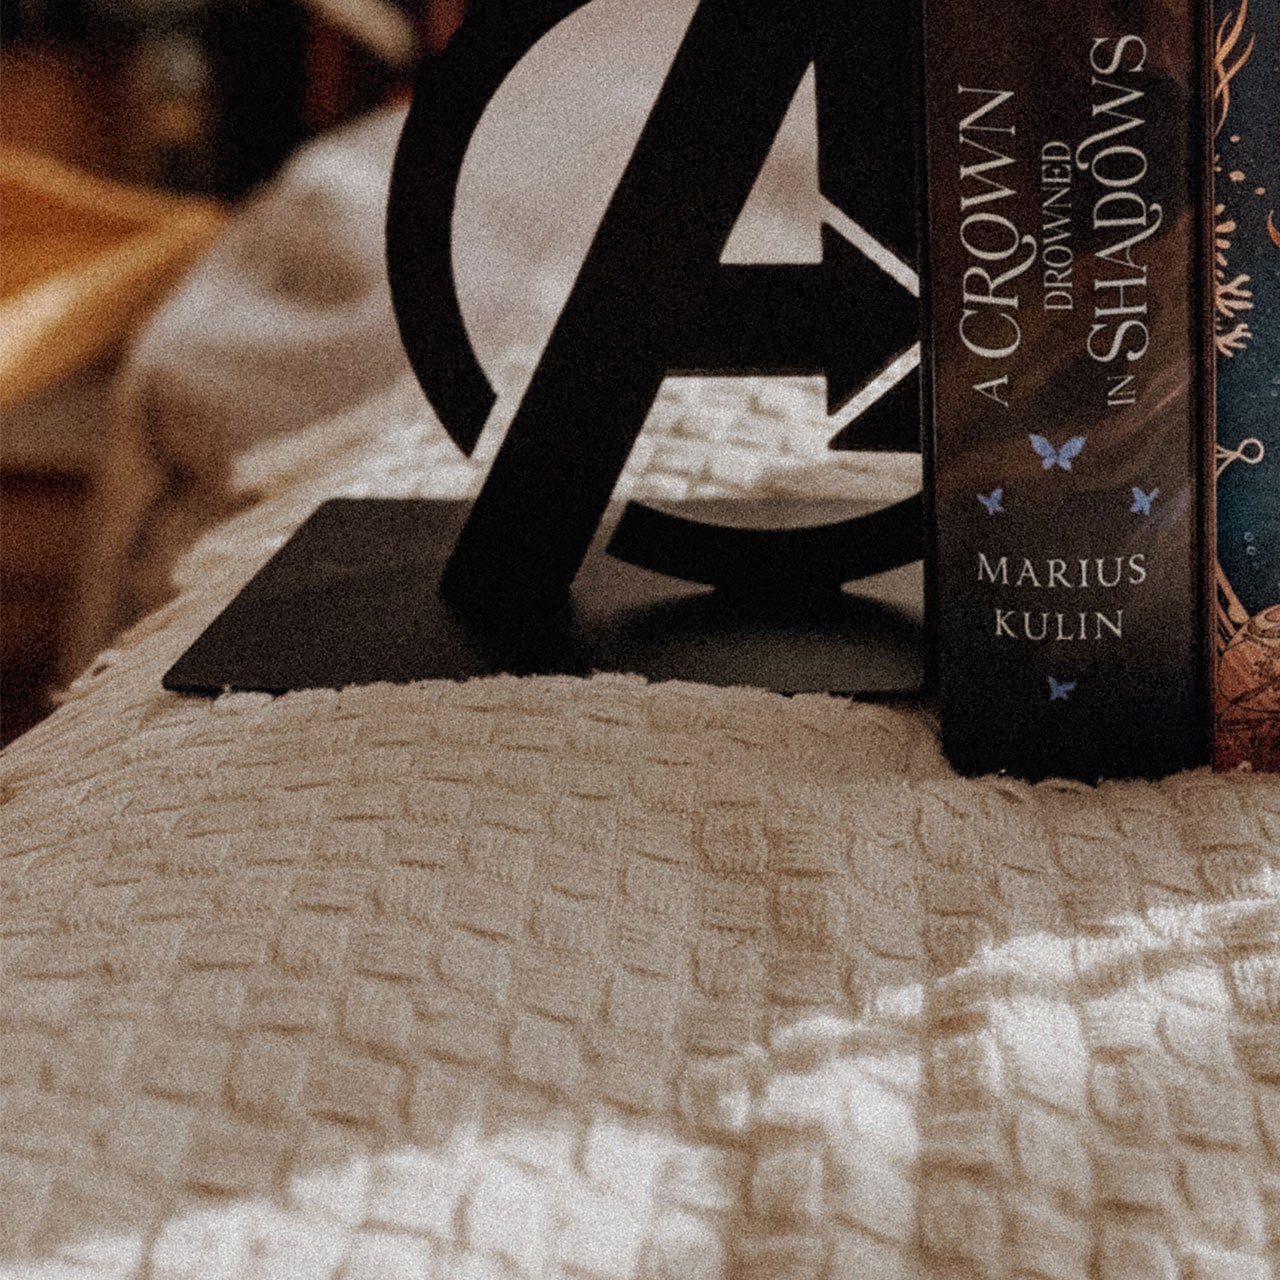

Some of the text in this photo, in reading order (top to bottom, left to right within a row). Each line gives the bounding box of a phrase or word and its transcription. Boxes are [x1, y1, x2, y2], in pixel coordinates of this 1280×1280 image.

[957, 83, 1037, 408] A CROWN
[1041, 141, 1074, 310] DROWNED
[1075, 34, 1163, 406] IN SHADOWS
[977, 551, 1147, 589] MARIUS
[995, 608, 1124, 641] KULIN
